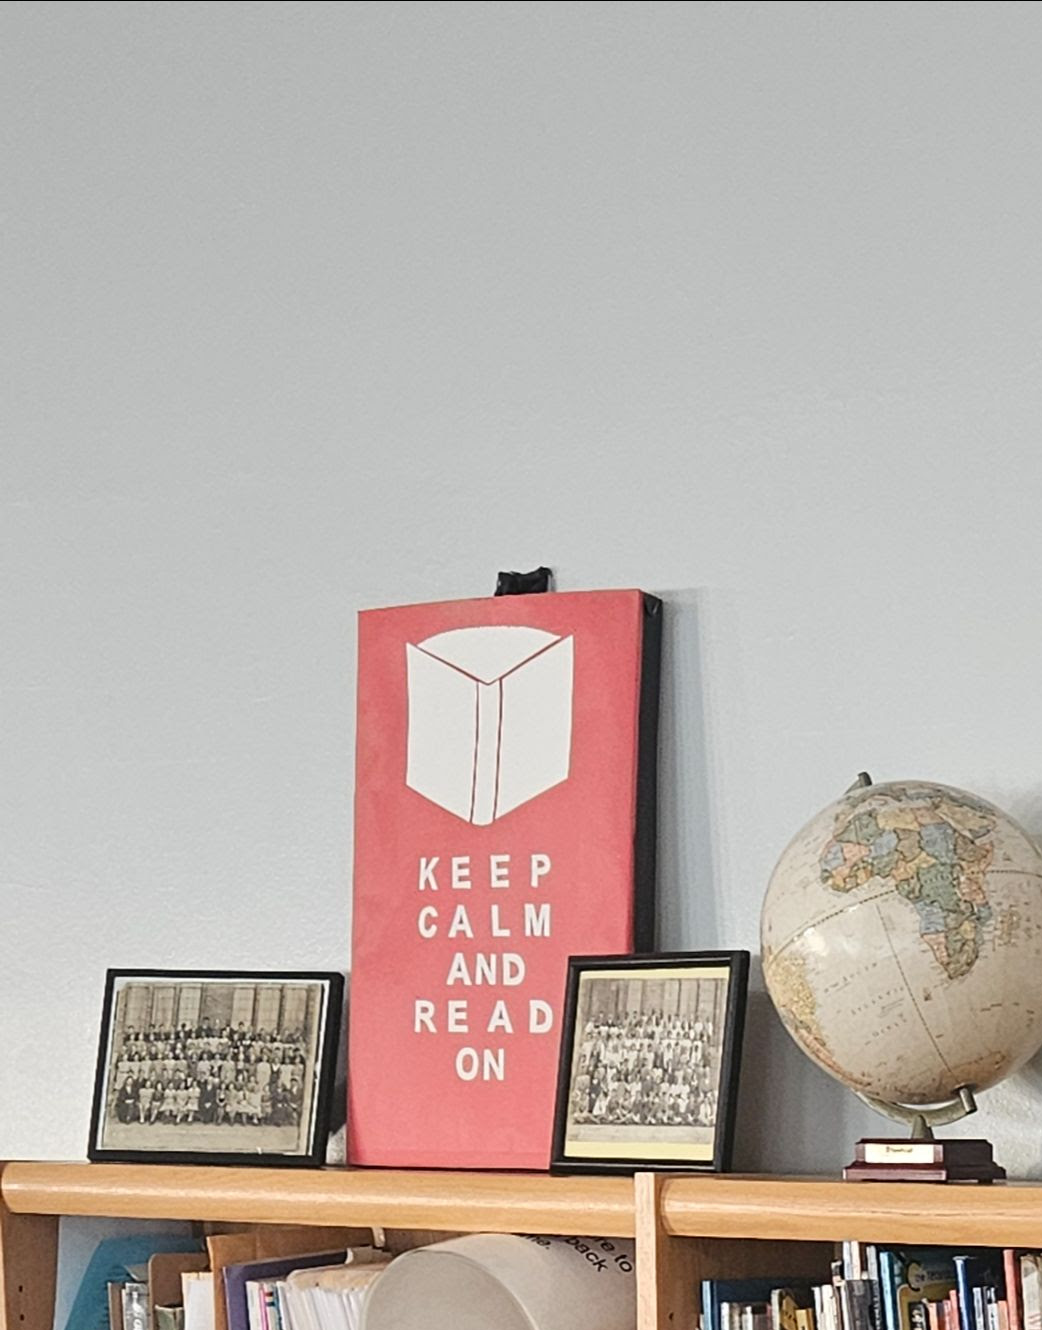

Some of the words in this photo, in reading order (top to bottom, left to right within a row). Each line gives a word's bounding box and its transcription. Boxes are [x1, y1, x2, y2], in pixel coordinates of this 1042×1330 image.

[418, 854, 551, 890] KEEP
[418, 903, 551, 938] CALM
[446, 952, 525, 986] AND
[414, 1000, 553, 1033] READ
[455, 1047, 504, 1081] ON
[565, 1237, 608, 1272] back
[614, 1254, 632, 1272] to
